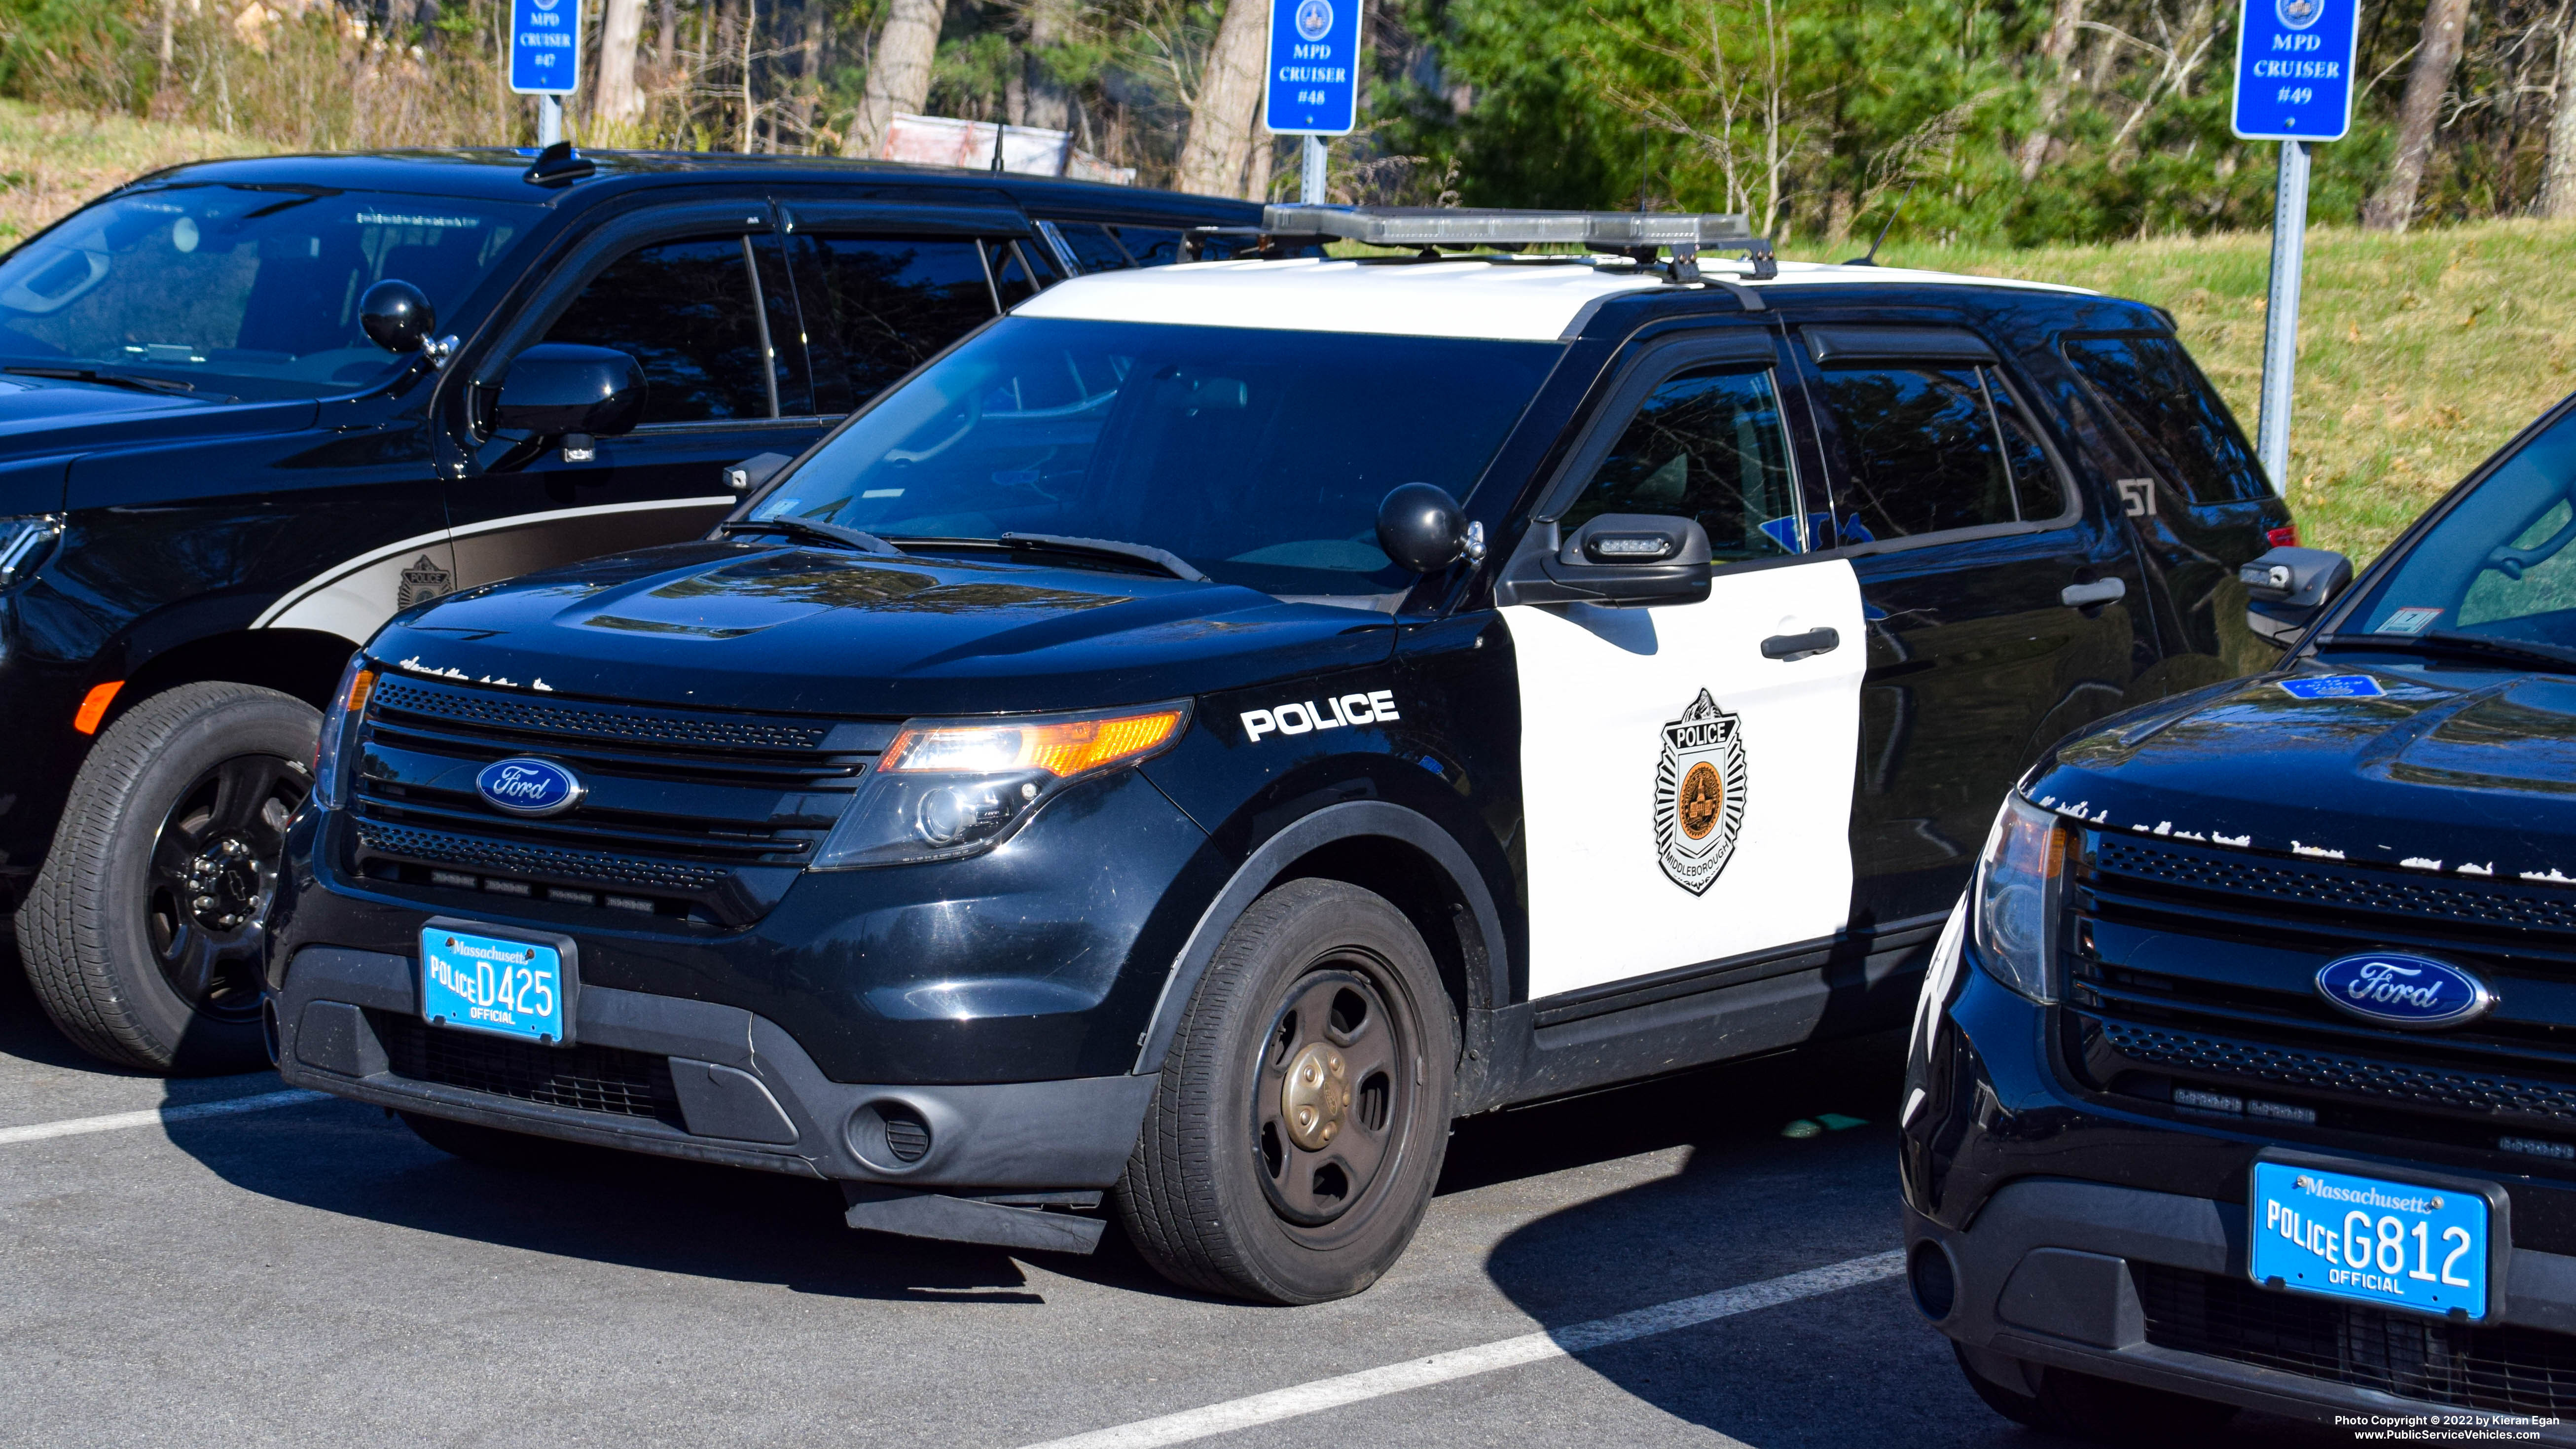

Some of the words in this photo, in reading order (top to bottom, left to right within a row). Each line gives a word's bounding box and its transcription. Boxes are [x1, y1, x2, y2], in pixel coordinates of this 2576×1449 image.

[531, 13, 559, 27] MPD
[520, 33, 571, 47] CRUISER
[2271, 34, 2321, 51] MPD
[534, 53, 556, 68] #47
[1293, 44, 1331, 60] MPD
[1279, 66, 1345, 83] CRUISER
[2253, 60, 2340, 78] CRUISER
[1298, 89, 1325, 106] #48
[2277, 86, 2313, 105] #49
[2116, 477, 2157, 517] 57
[411, 573, 442, 583] POLICE
[1240, 689, 1400, 742] POLICE
[1677, 723, 1726, 748] POLICE
[493, 766, 550, 799] Ford
[1665, 841, 1729, 877] MIDDLEBOROUGH
[453, 940, 528, 965] Massachusetts
[431, 955, 476, 1004] POLICE
[477, 961, 552, 1017] D425
[2348, 962, 2443, 1008] Ford
[471, 1007, 516, 1025] OFFICIAL
[2306, 1177, 2432, 1214] Massachusetts
[2267, 1198, 2339, 1264] POLICE
[2344, 1210, 2471, 1288] G812
[2329, 1268, 2404, 1295] OFFICIAL
